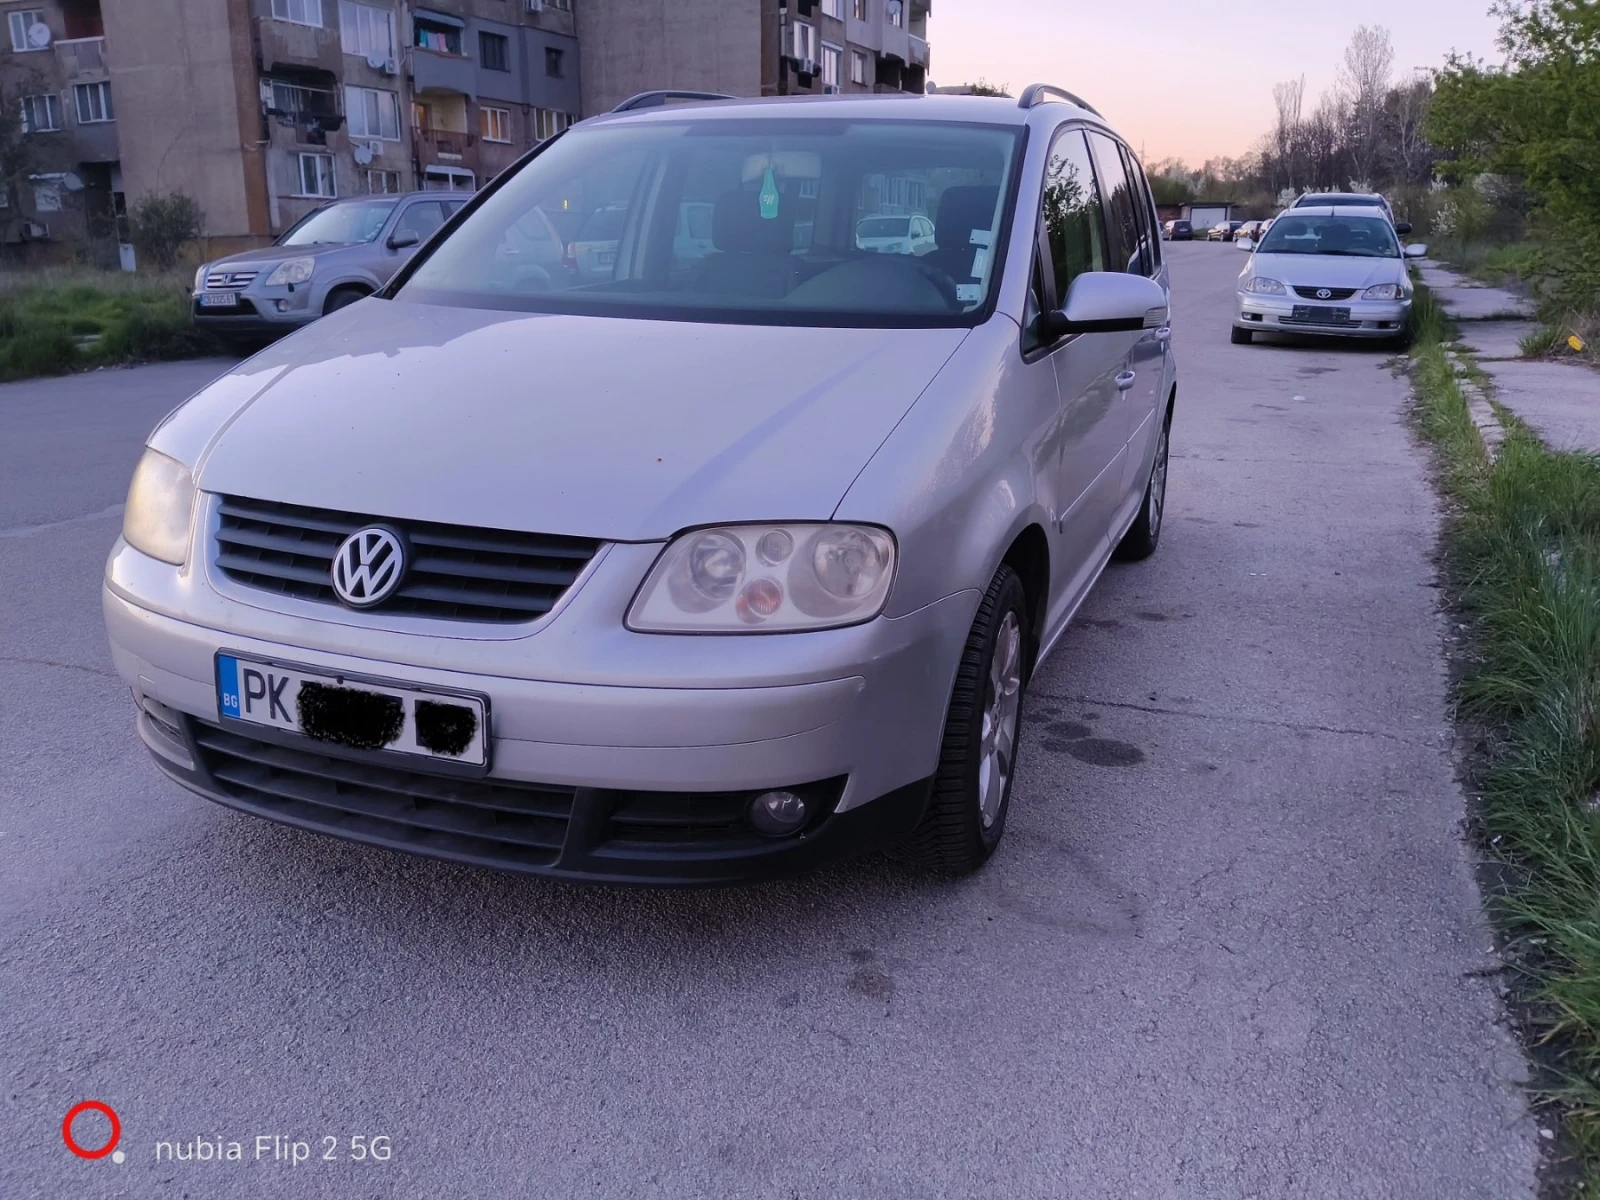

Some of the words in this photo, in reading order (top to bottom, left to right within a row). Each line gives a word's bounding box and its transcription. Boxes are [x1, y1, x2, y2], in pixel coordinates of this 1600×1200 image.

[333, 528, 403, 604] VW
[223, 692, 238, 708] BG
[243, 668, 293, 723] PK
